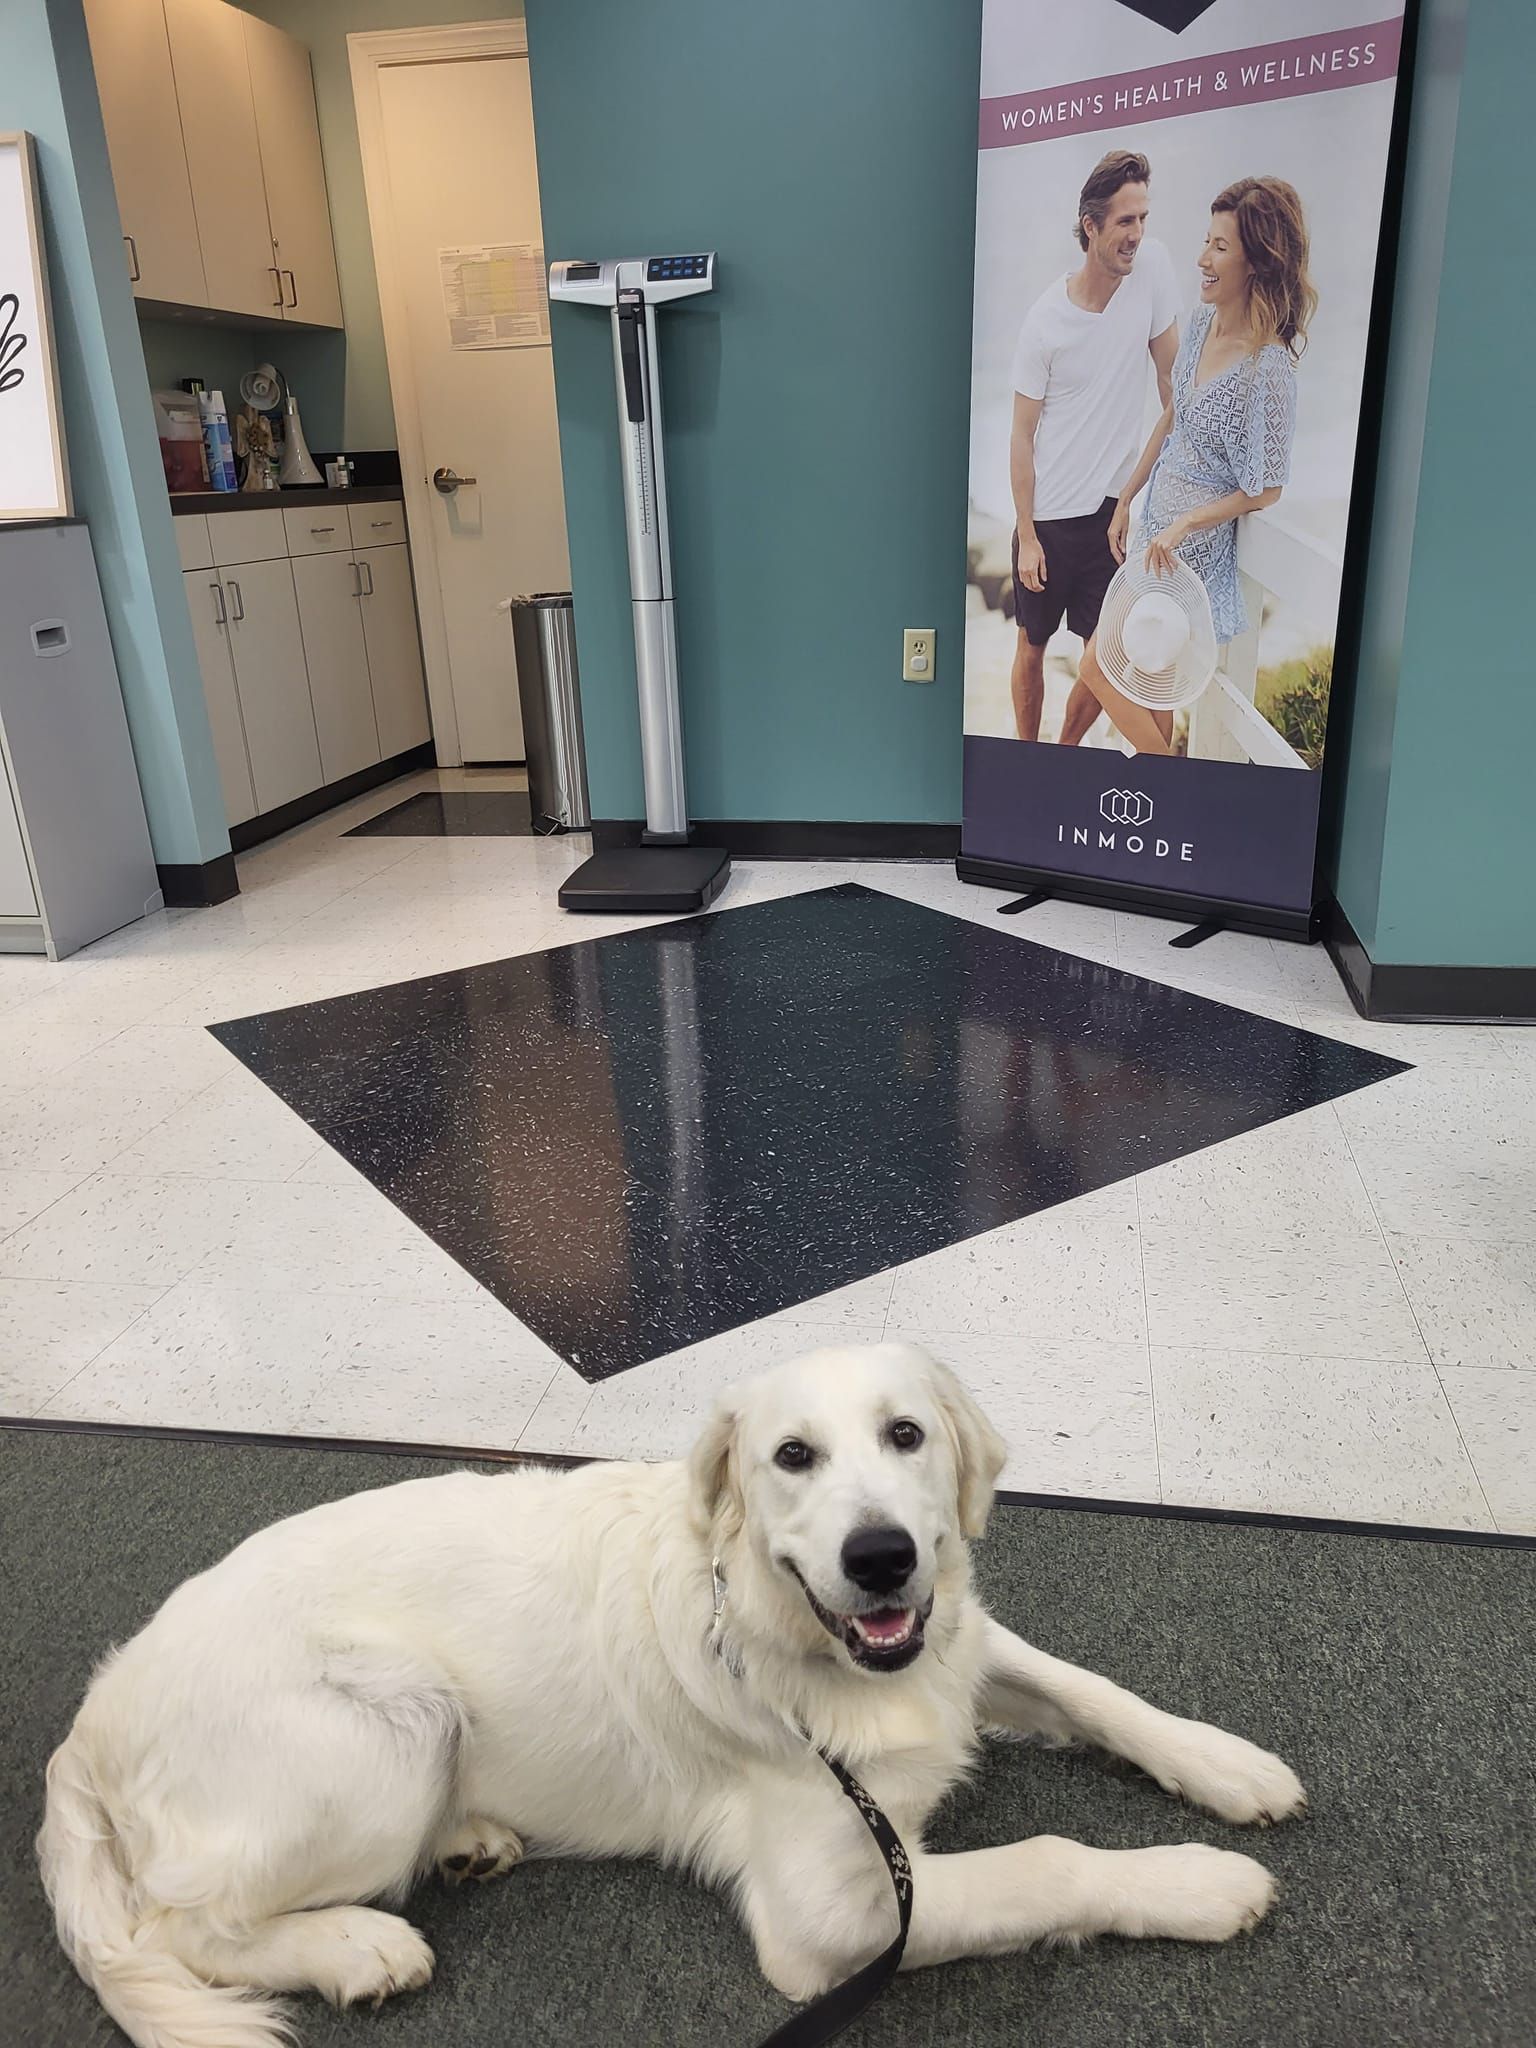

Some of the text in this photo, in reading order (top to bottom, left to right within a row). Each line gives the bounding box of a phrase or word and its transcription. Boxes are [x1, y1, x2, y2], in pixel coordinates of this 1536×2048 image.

[1001, 42, 1377, 131] WOMEN'S HEALTH & WELLNESS
[1058, 824, 1194, 862] INMODE
